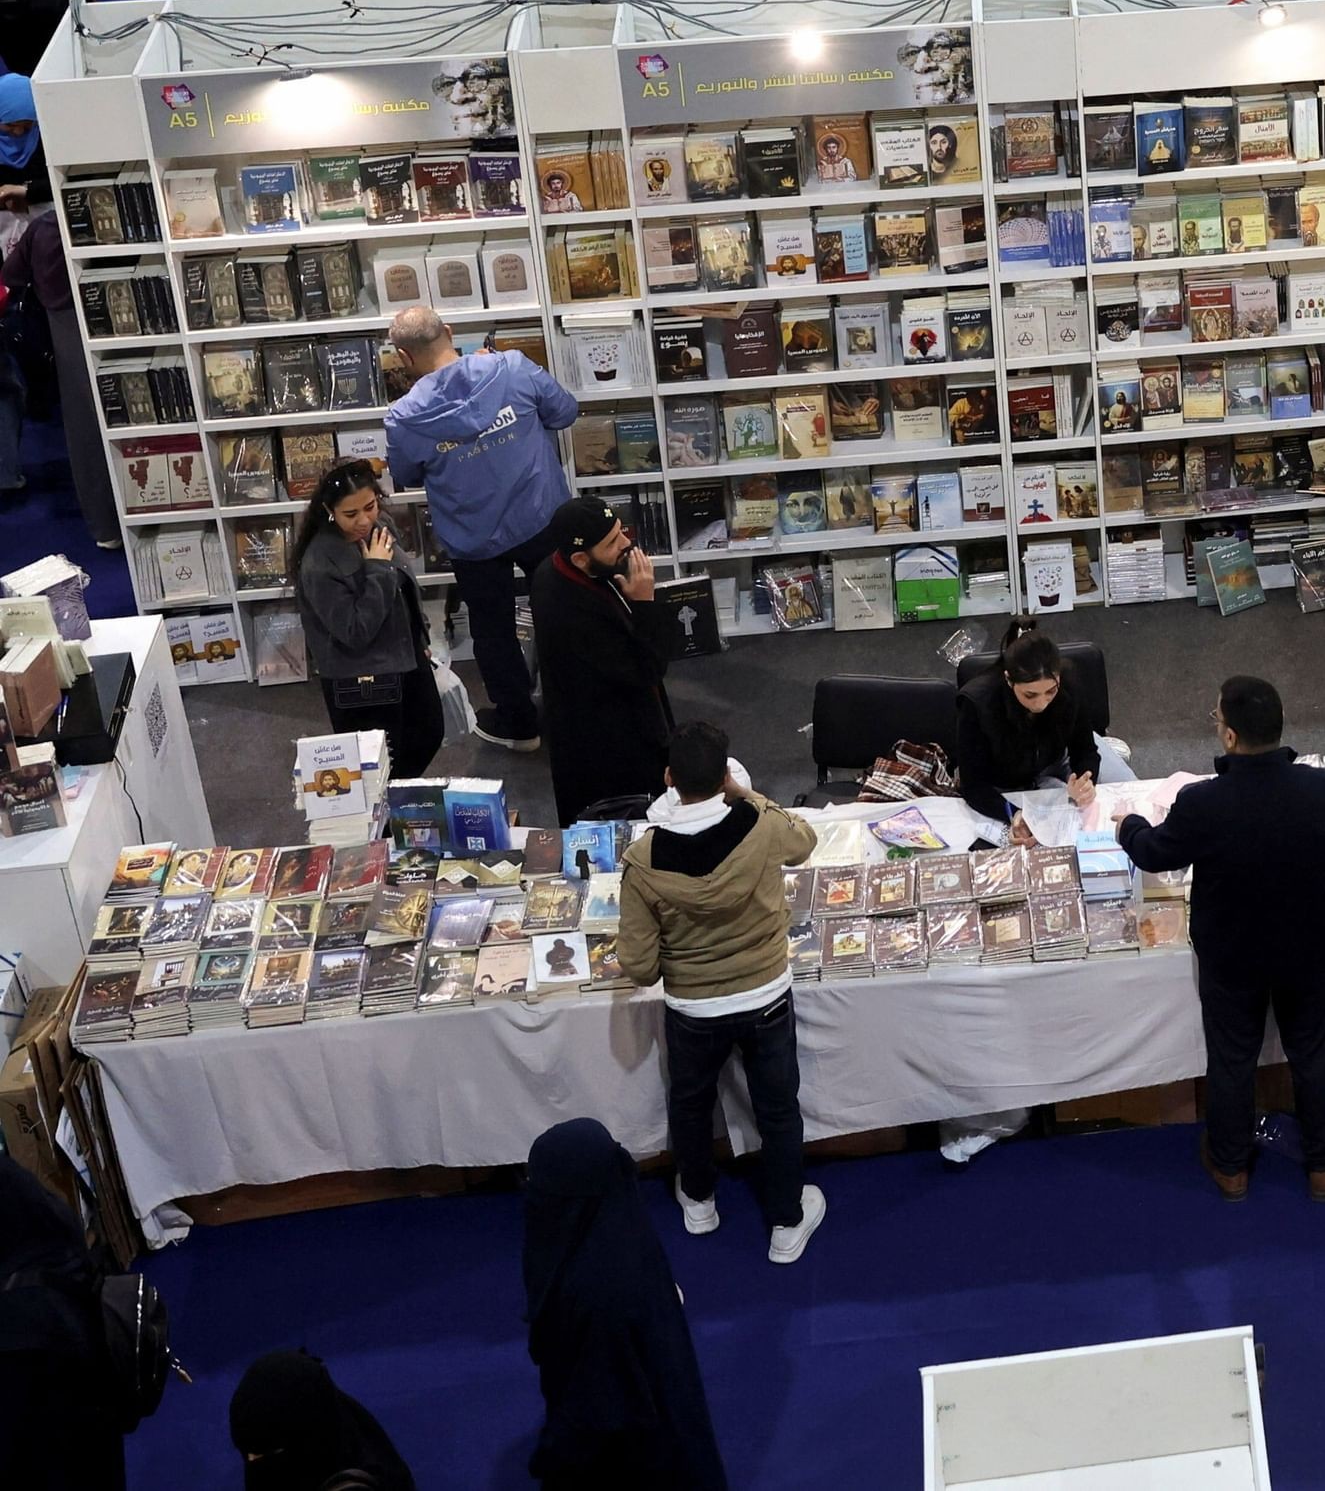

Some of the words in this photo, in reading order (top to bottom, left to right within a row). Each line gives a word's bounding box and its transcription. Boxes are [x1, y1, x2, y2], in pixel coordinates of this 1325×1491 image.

[763, 73, 798, 91] للنشر
[848, 68, 894, 82] مكتبة
[643, 81, 670, 98] A5
[702, 76, 758, 95] والتوزيع
[382, 99, 431, 113] مكتبة
[169, 113, 198, 129] A5
